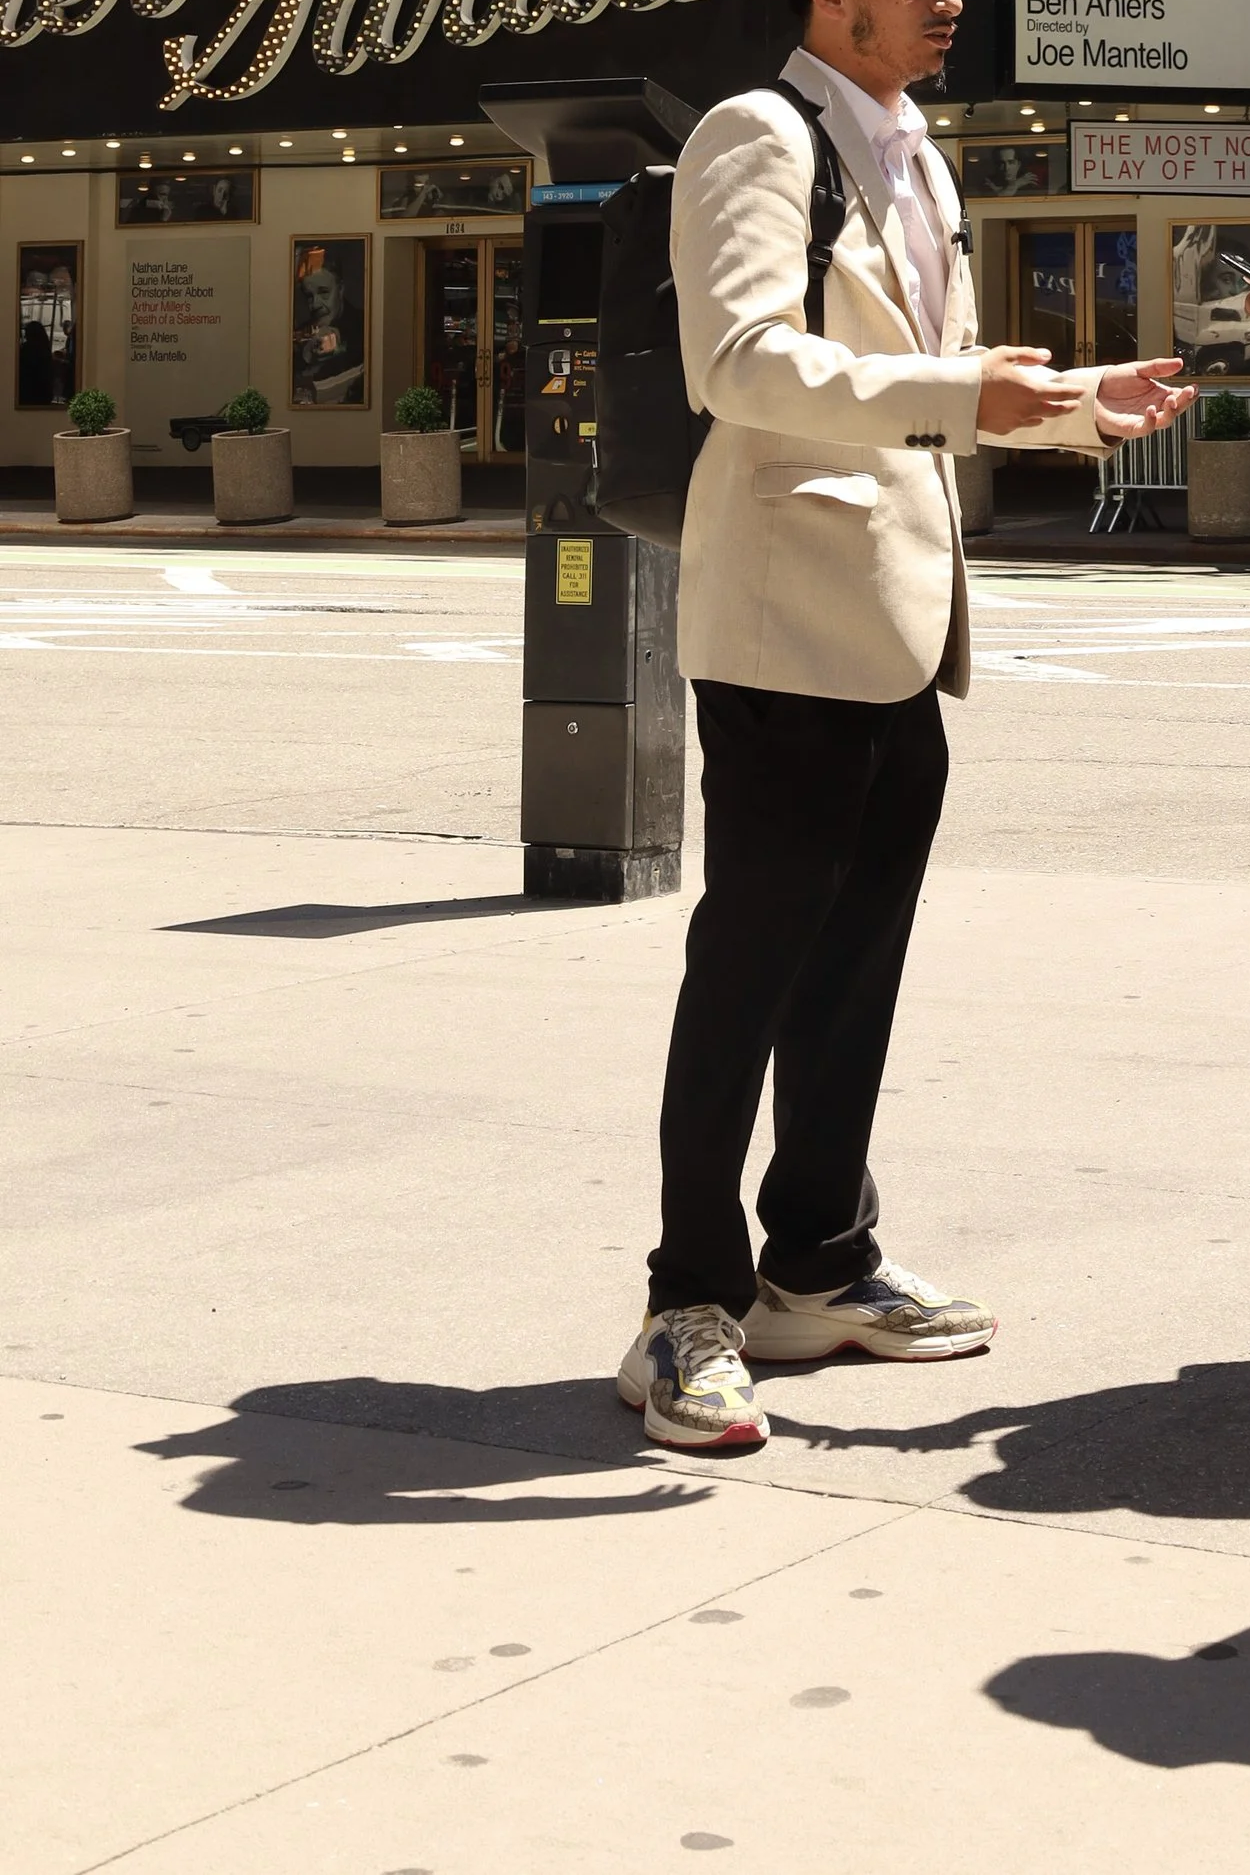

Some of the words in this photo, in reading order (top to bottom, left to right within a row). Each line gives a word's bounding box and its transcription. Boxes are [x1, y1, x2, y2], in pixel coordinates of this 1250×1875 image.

[1027, 18, 1072, 34] Directed
[1075, 21, 1090, 37] by
[1027, 38, 1075, 67] Joe
[1082, 40, 1188, 71] Mantello
[1084, 133, 1131, 156] THE
[1144, 134, 1211, 157] MOST
[1083, 158, 1146, 180] PLAY
[1162, 159, 1196, 181] OF
[446, 223, 465, 233] 1634
[132, 262, 162, 273] Nathan
[165, 263, 188, 273] Lane
[132, 275, 158, 286] Laurie
[161, 274, 193, 285] Metcalf
[132, 287, 182, 299] Christopher
[185, 287, 213, 298] Abbott
[132, 301, 158, 312] Arthur
[131, 314, 157, 324] Death
[177, 313, 220, 324] Salesman
[131, 332, 148, 343] Ben
[151, 332, 178, 343] Ahlers
[131, 351, 147, 362] Joe
[149, 351, 186, 361] Mantello
